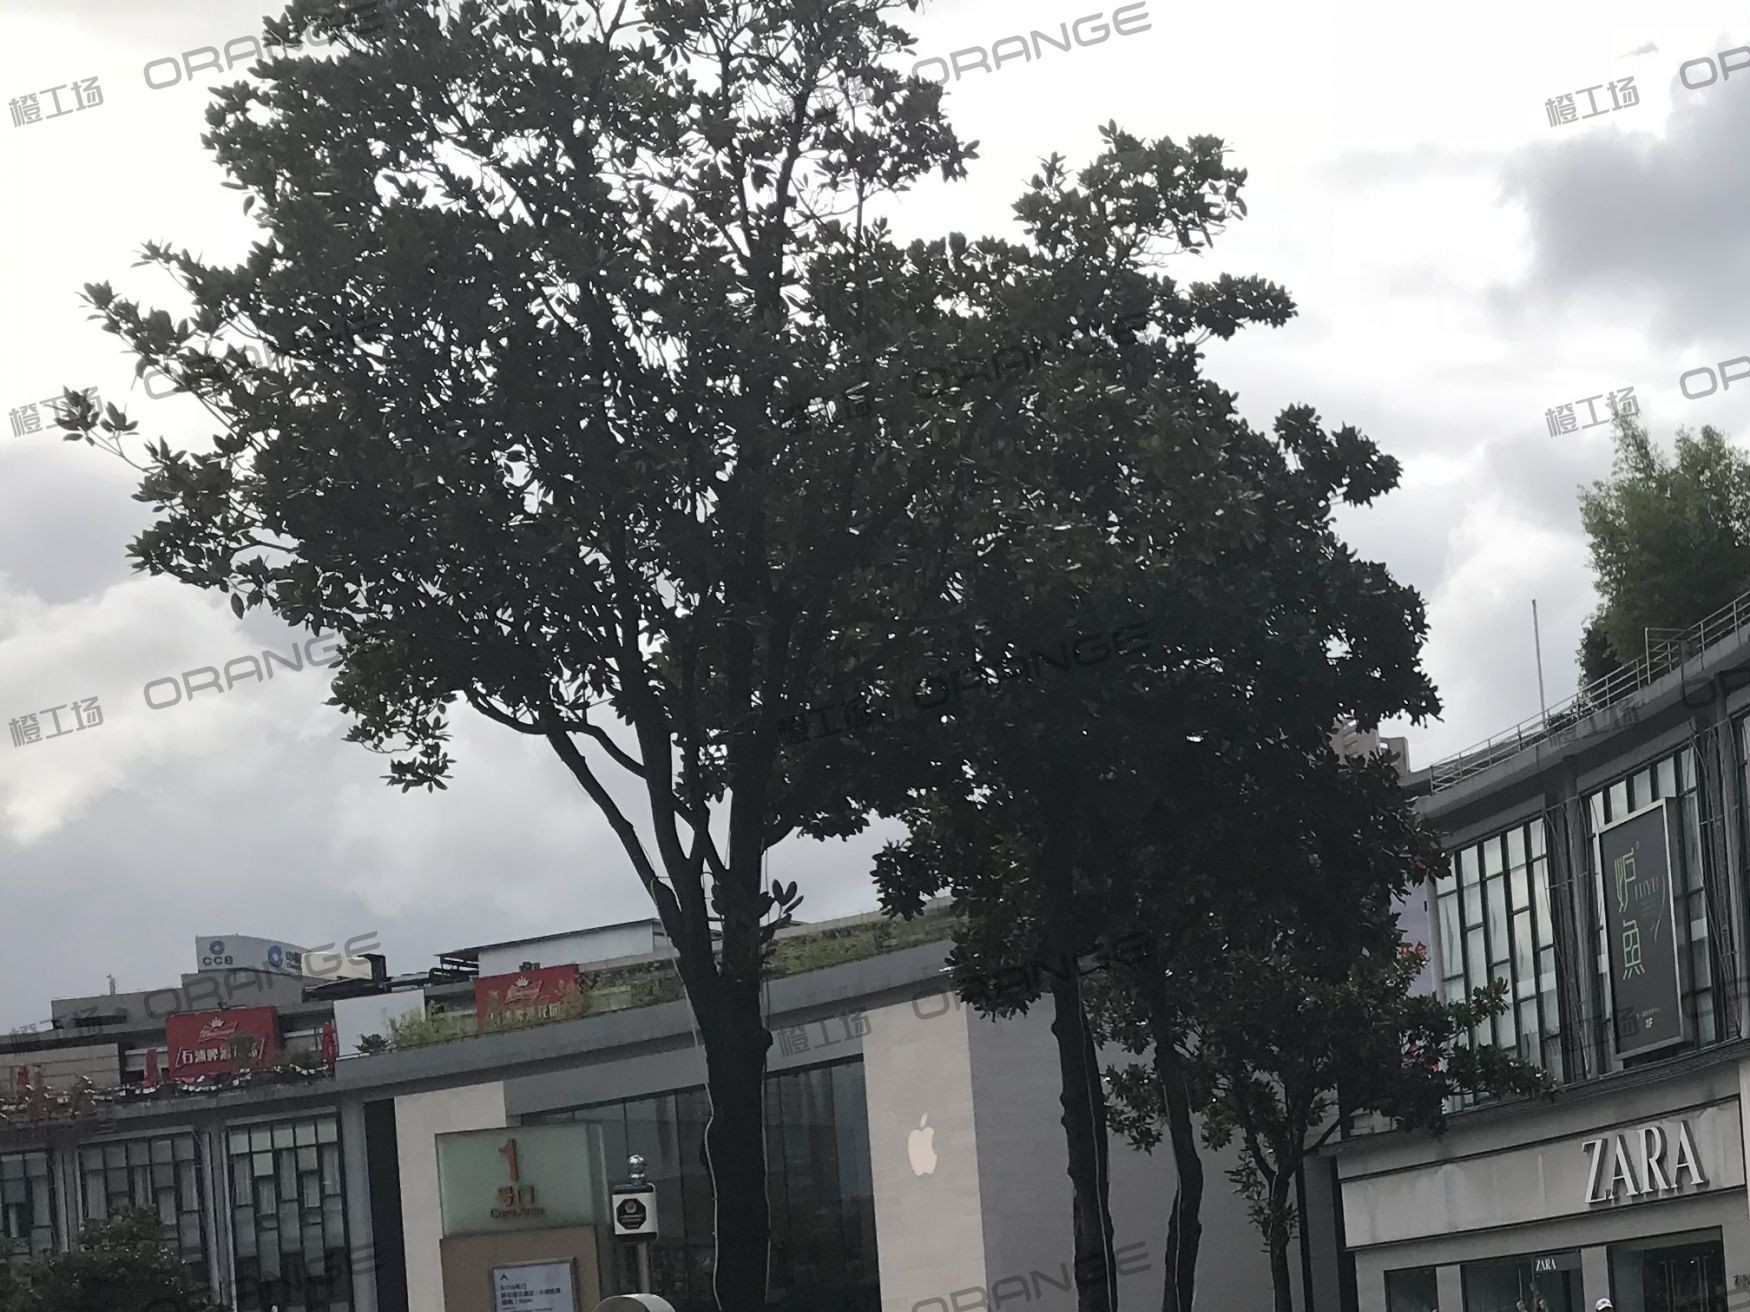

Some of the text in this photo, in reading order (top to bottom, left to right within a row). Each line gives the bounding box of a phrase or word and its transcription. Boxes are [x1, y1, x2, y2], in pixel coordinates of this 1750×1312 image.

[202, 956, 233, 966] CCB
[498, 1138, 519, 1182] 1
[1580, 1120, 1709, 1205] ZARA
[496, 1185, 535, 1208] 号门
[1535, 1258, 1557, 1272] ZARA
